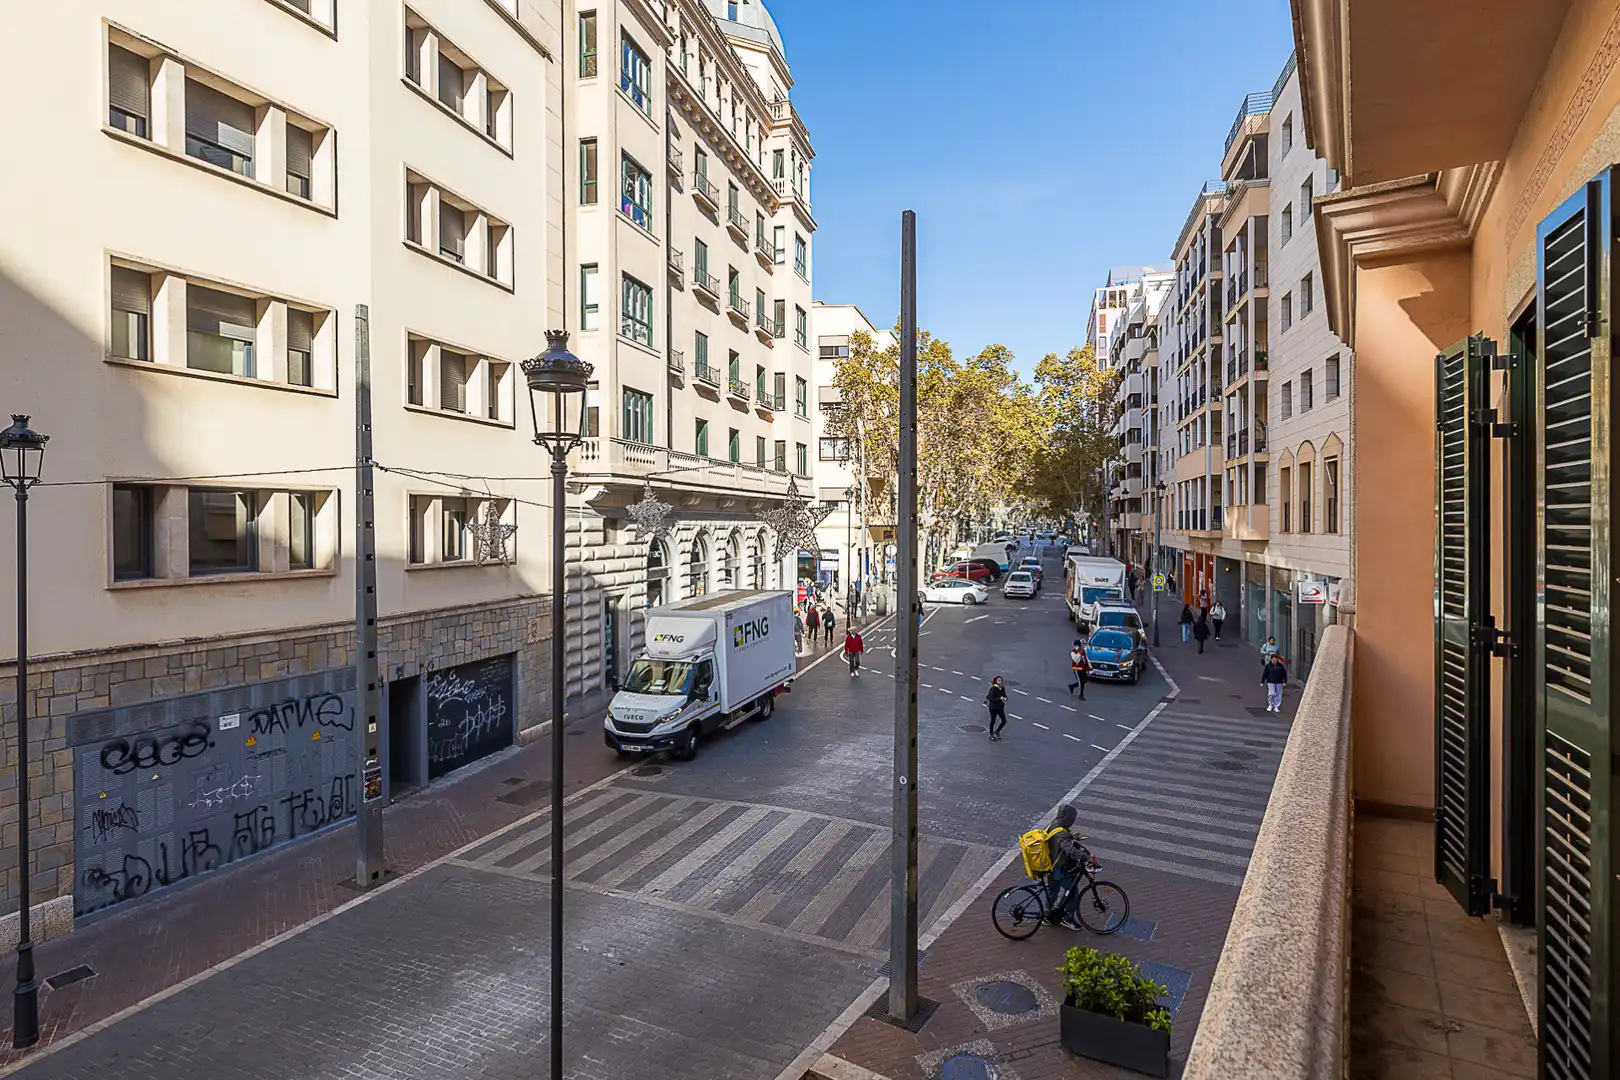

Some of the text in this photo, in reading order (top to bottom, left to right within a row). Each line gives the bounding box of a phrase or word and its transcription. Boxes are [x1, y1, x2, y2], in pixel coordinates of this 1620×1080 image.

[744, 616, 769, 644] FNG
[662, 634, 685, 643] FNG
[623, 713, 644, 721] IVECO
